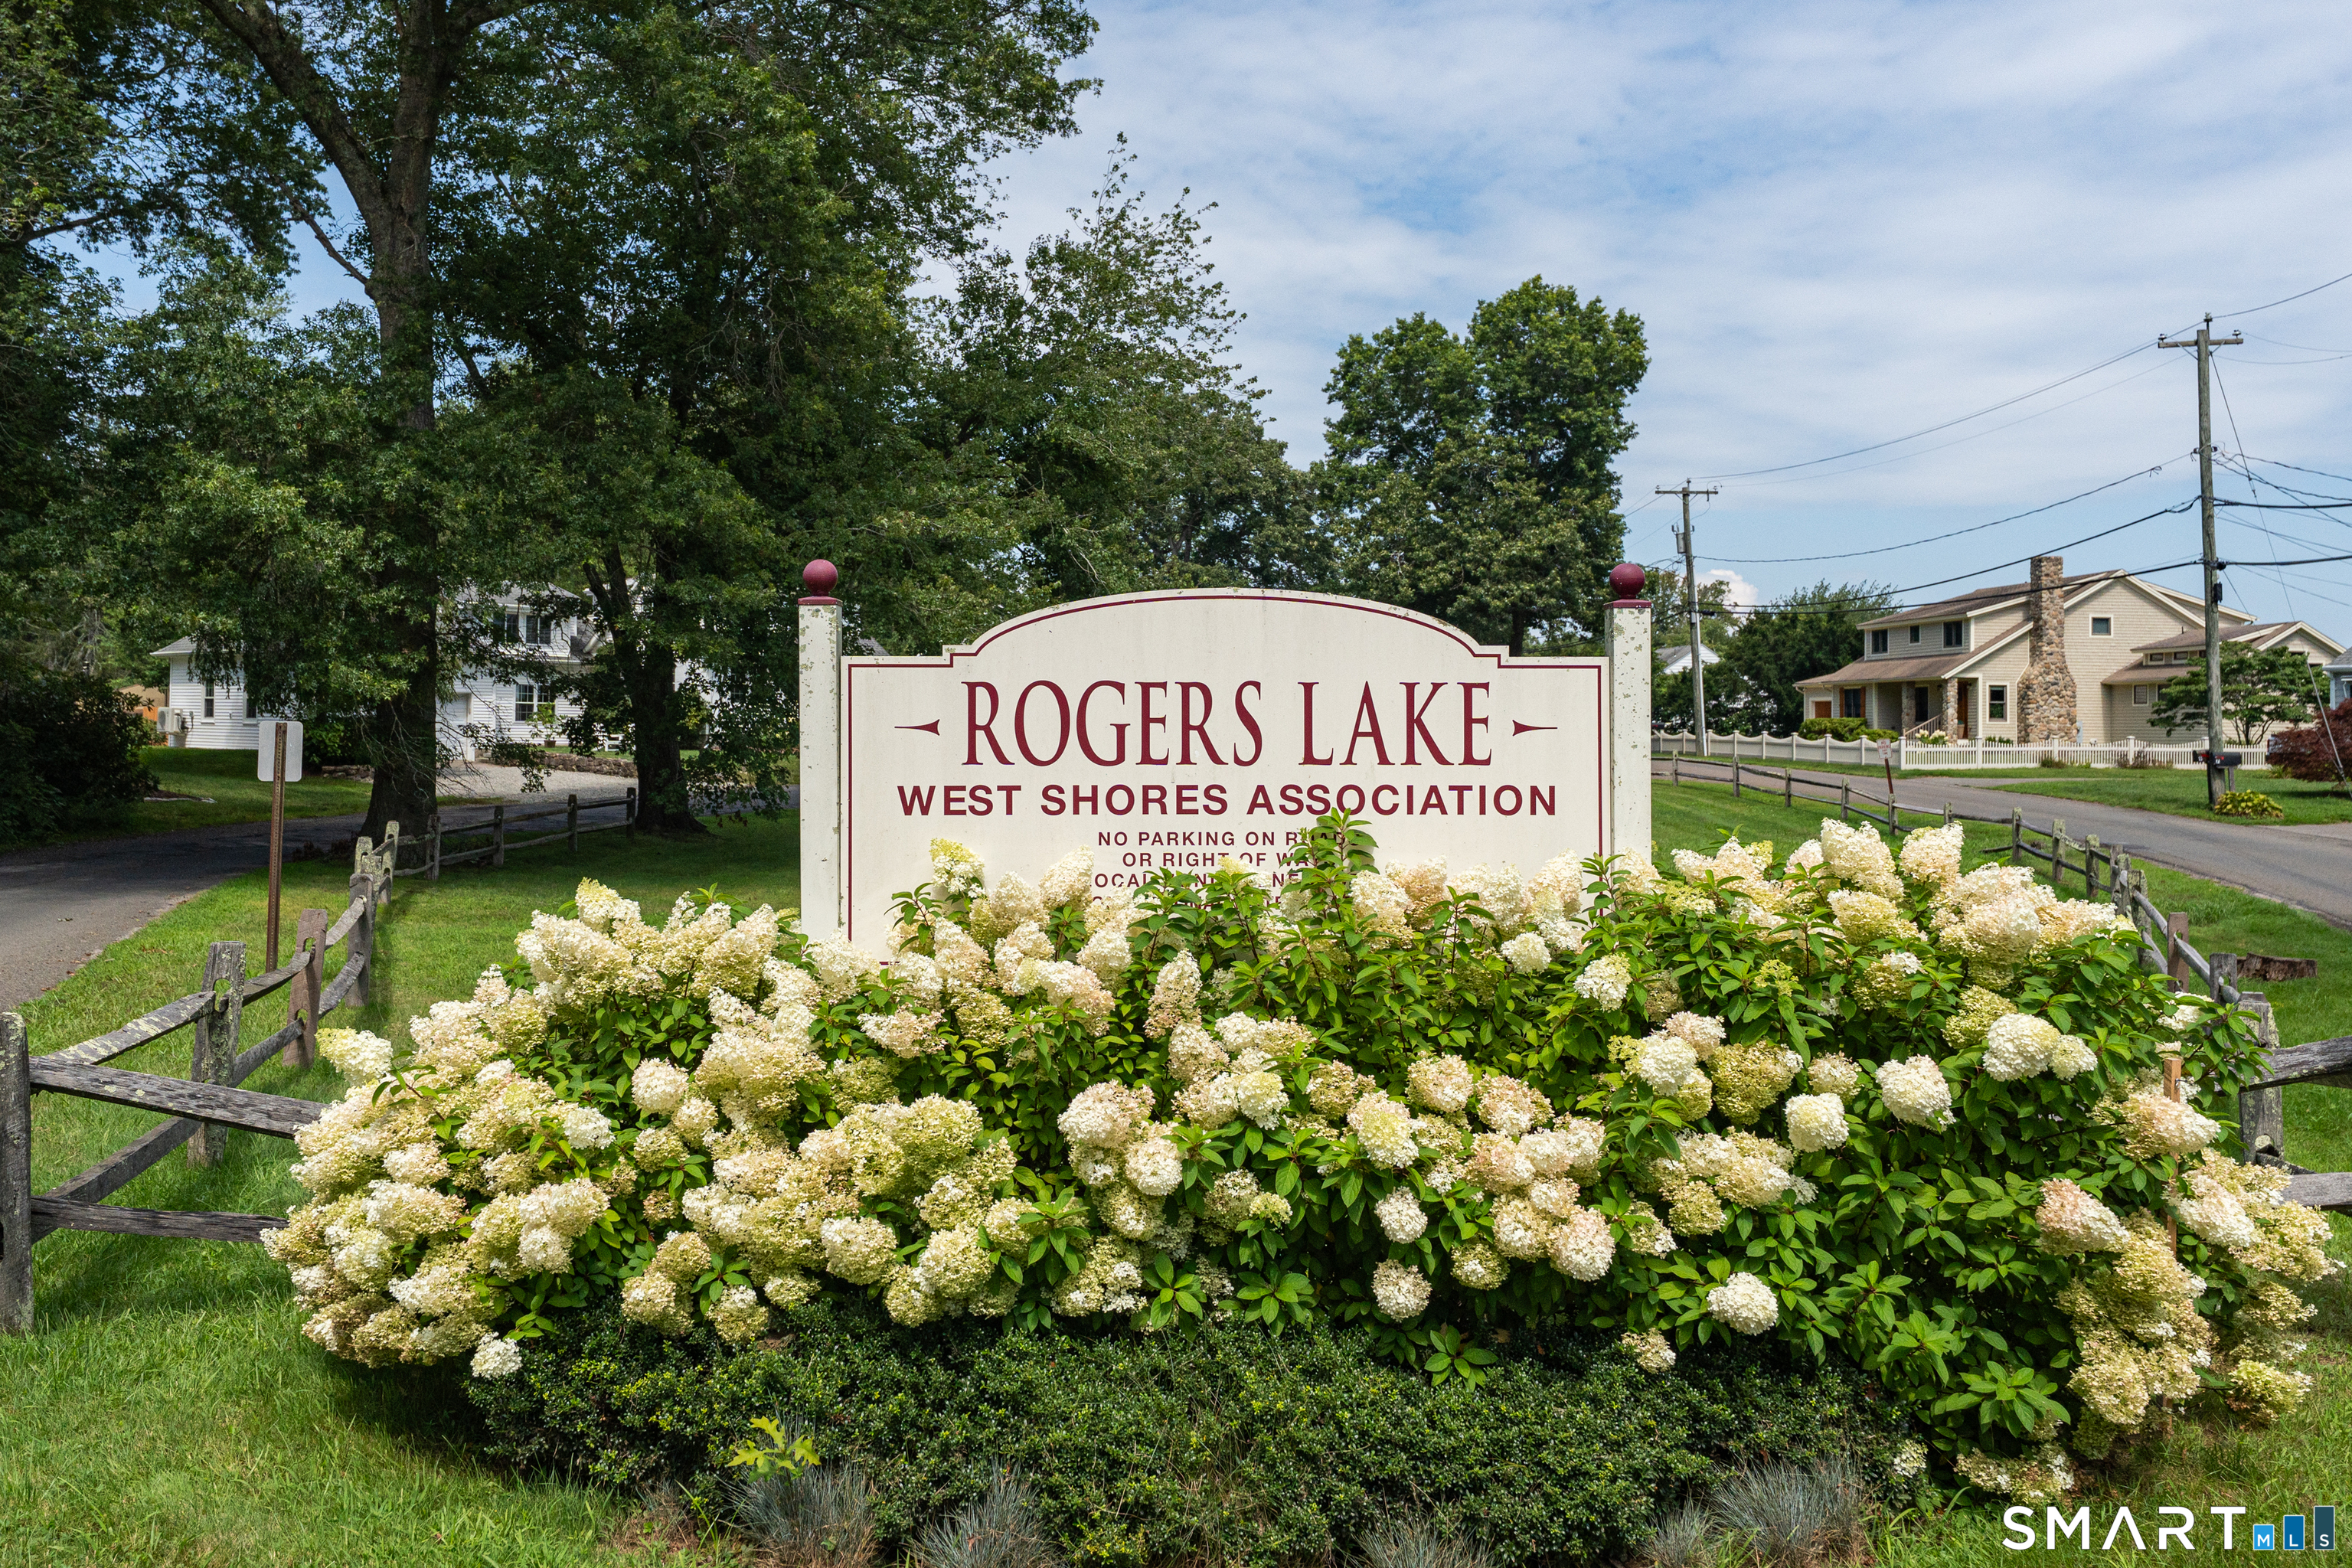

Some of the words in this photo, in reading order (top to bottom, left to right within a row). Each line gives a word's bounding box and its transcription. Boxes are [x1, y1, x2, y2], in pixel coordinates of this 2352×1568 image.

[962, 680, 1263, 767] ROGERS
[1298, 680, 1492, 766] LAKE
[897, 784, 1021, 816] WEST
[1040, 783, 1228, 817] SHORES
[1246, 783, 1557, 817] ASSOCIATION
[1098, 831, 1128, 846] NO
[1138, 831, 1235, 846] PARKING
[1245, 831, 1275, 846] ON
[1122, 852, 1152, 867] OR
[1240, 852, 1267, 867] OF
